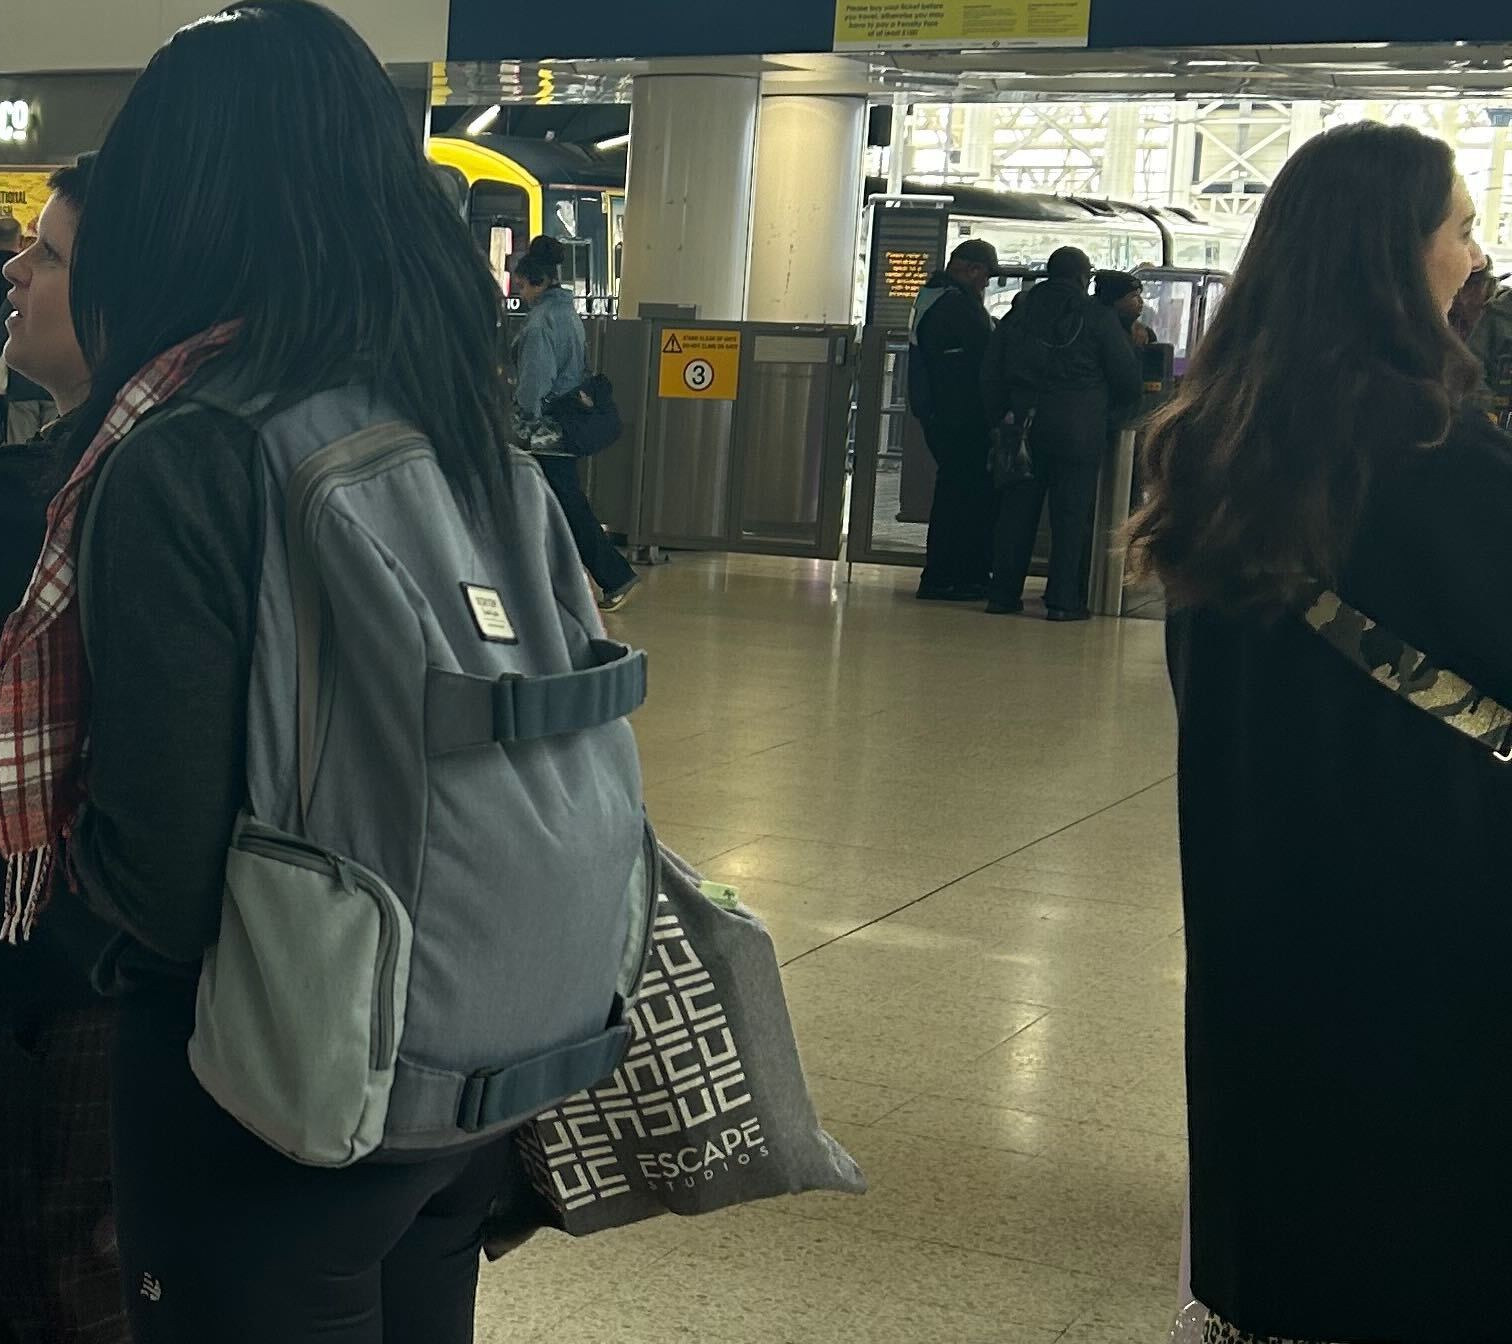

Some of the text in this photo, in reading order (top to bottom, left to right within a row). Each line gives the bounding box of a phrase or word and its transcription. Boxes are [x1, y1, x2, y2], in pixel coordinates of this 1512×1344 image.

[692, 365, 705, 385] 3
[636, 1116, 766, 1179] ESCAPE
[647, 1145, 770, 1193] STUDIOS
